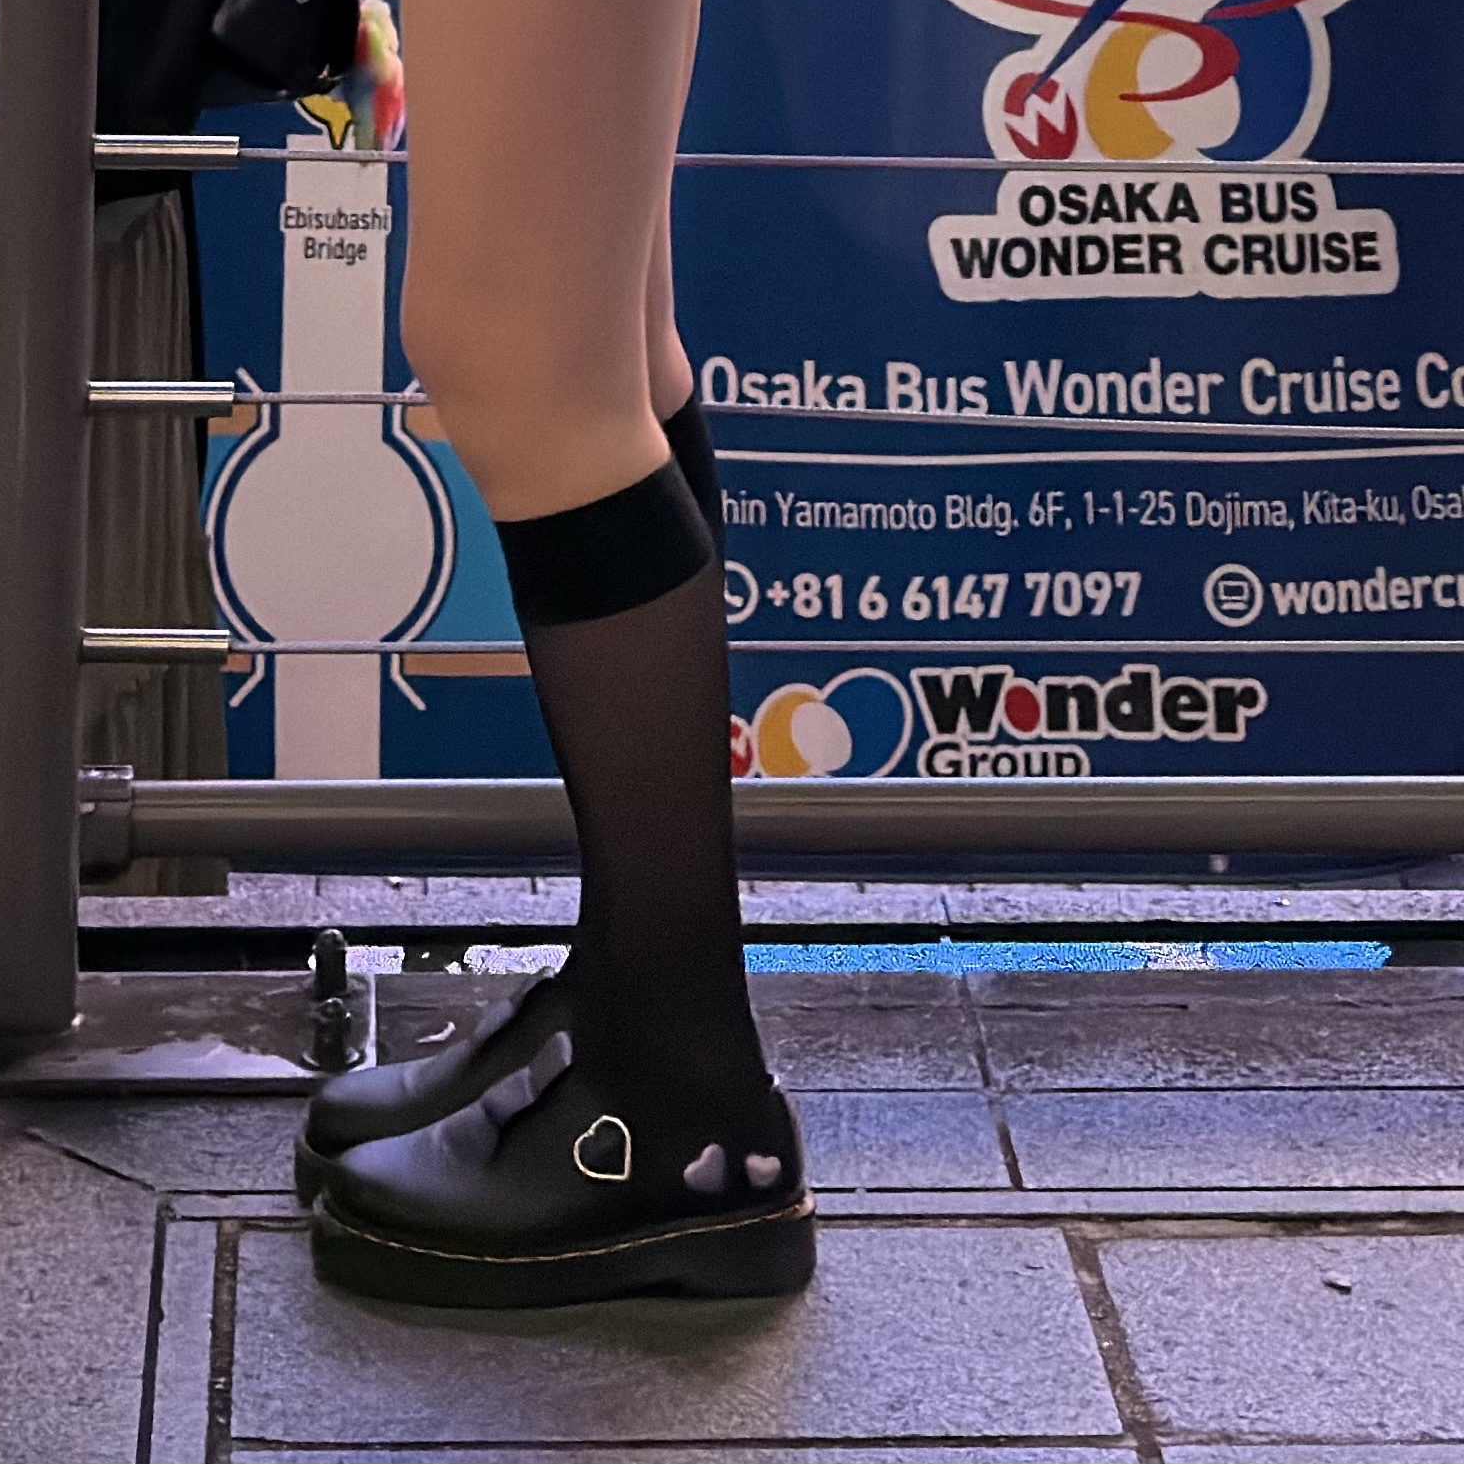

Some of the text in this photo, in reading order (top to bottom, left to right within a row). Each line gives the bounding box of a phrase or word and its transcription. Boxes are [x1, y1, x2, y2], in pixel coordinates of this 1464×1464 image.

[284, 206, 389, 230] Ebisubashi
[1019, 182, 1318, 226] OSAKA BUS
[303, 237, 367, 265] Bridge
[951, 231, 1381, 279] WONDER CRUISE
[701, 356, 866, 411] Osaka
[886, 361, 988, 416] Bus
[1004, 357, 1224, 416] Wonder
[1241, 356, 1401, 415] Cruise
[775, 492, 936, 530] Yamamoto
[945, 494, 1020, 537] Bldg.
[1028, 491, 1073, 531] 6F,
[1084, 490, 1176, 527] 1-1-25
[1186, 491, 1295, 535] Dojima,
[1303, 488, 1406, 526] Kita-ku,
[766, 571, 1142, 621] +81 6 6147 7097
[916, 670, 1261, 736] Wonder
[924, 743, 1087, 777] Group
